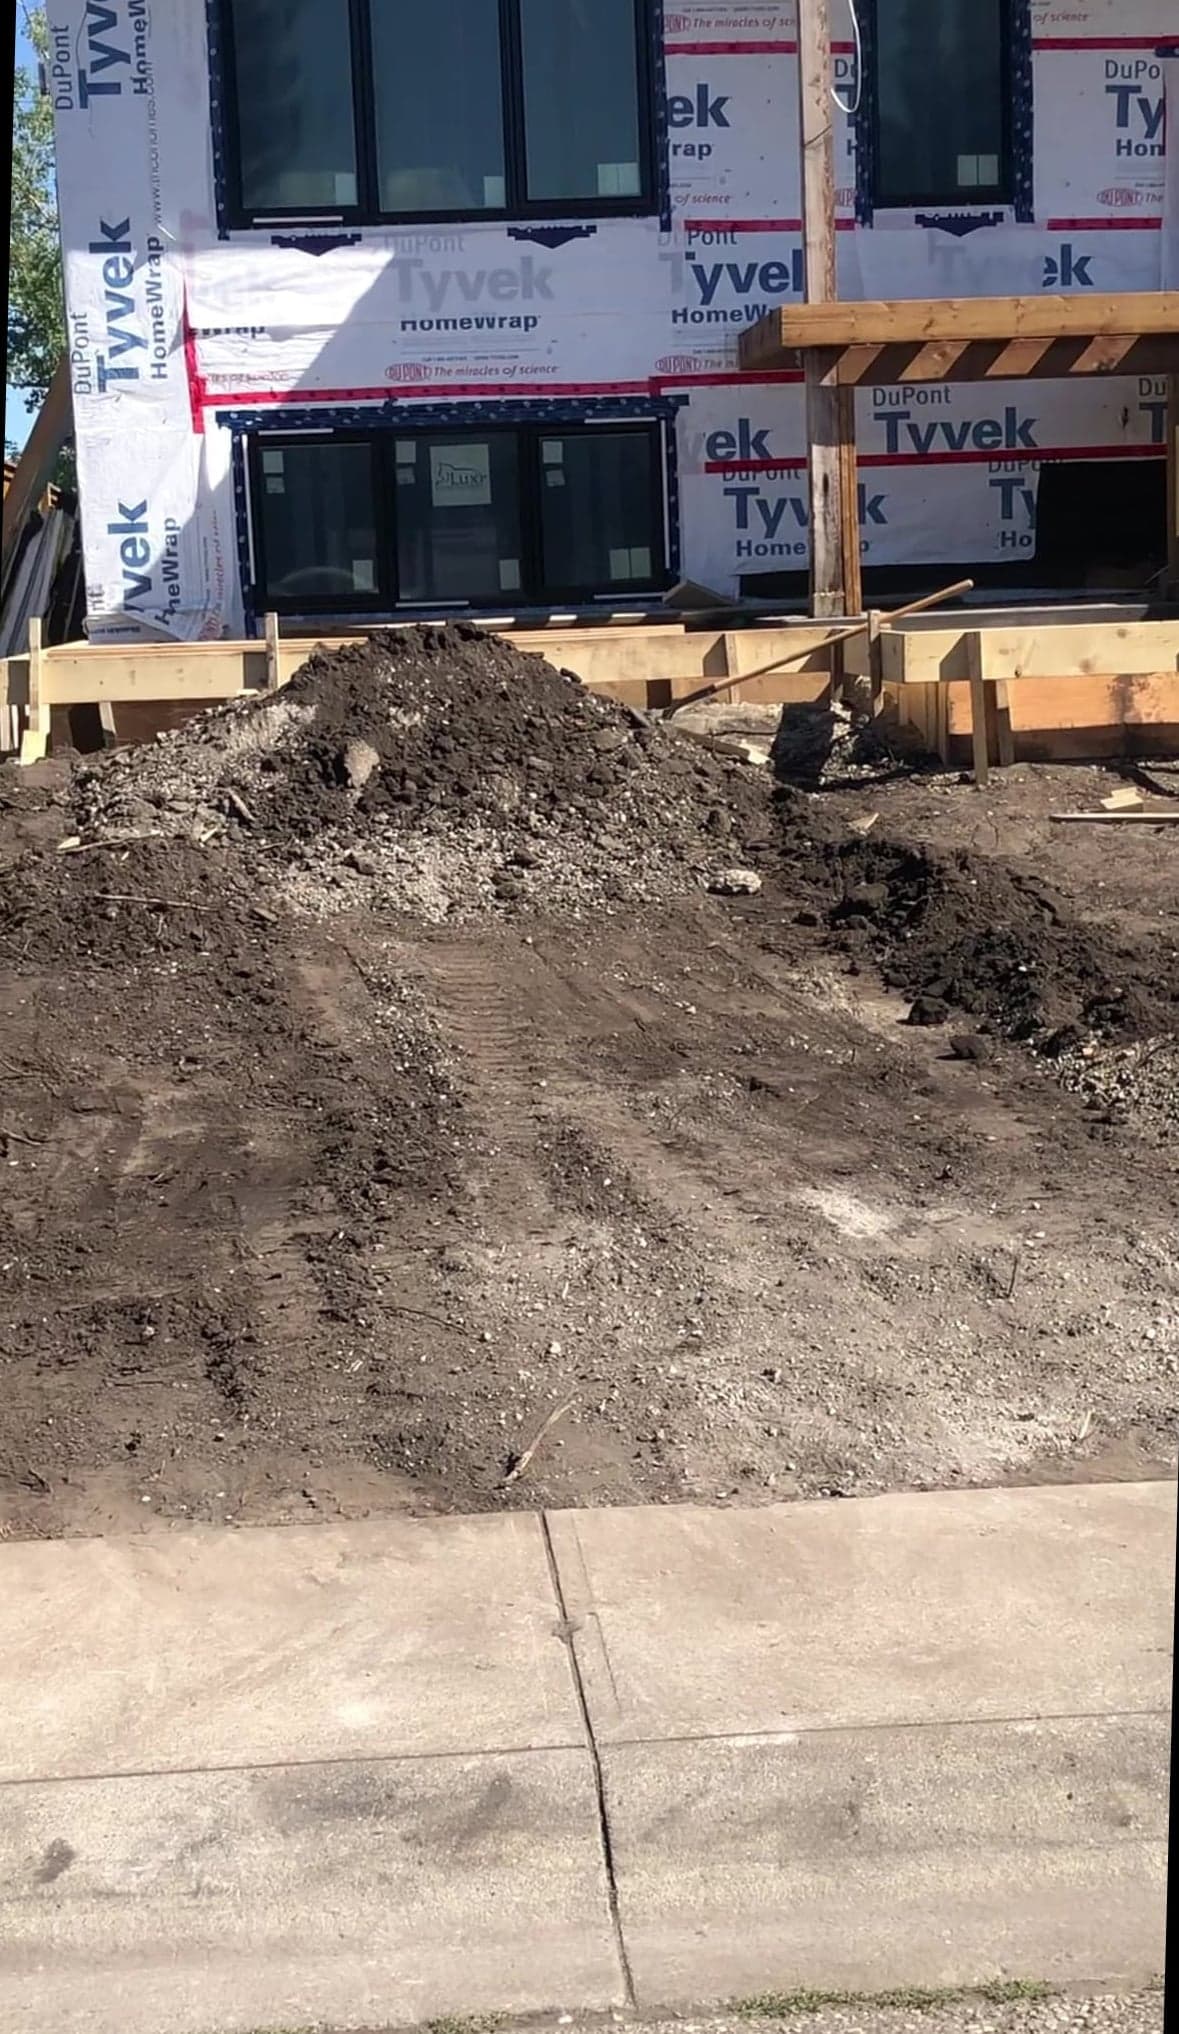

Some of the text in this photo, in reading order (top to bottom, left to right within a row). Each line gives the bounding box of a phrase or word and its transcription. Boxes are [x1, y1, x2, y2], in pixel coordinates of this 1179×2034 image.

[51, 25, 73, 110] DuPont
[668, 138, 713, 161] rap
[89, 216, 148, 392] Tyvek
[145, 236, 168, 379] HomeWrap
[389, 255, 556, 313] Tyvek
[671, 303, 774, 324] HomeW
[70, 312, 91, 394] DuPont
[434, 367, 453, 377] The
[455, 366, 500, 377] miracles
[502, 364, 517, 378] of
[519, 362, 561, 375] science
[872, 386, 952, 407] DuPont
